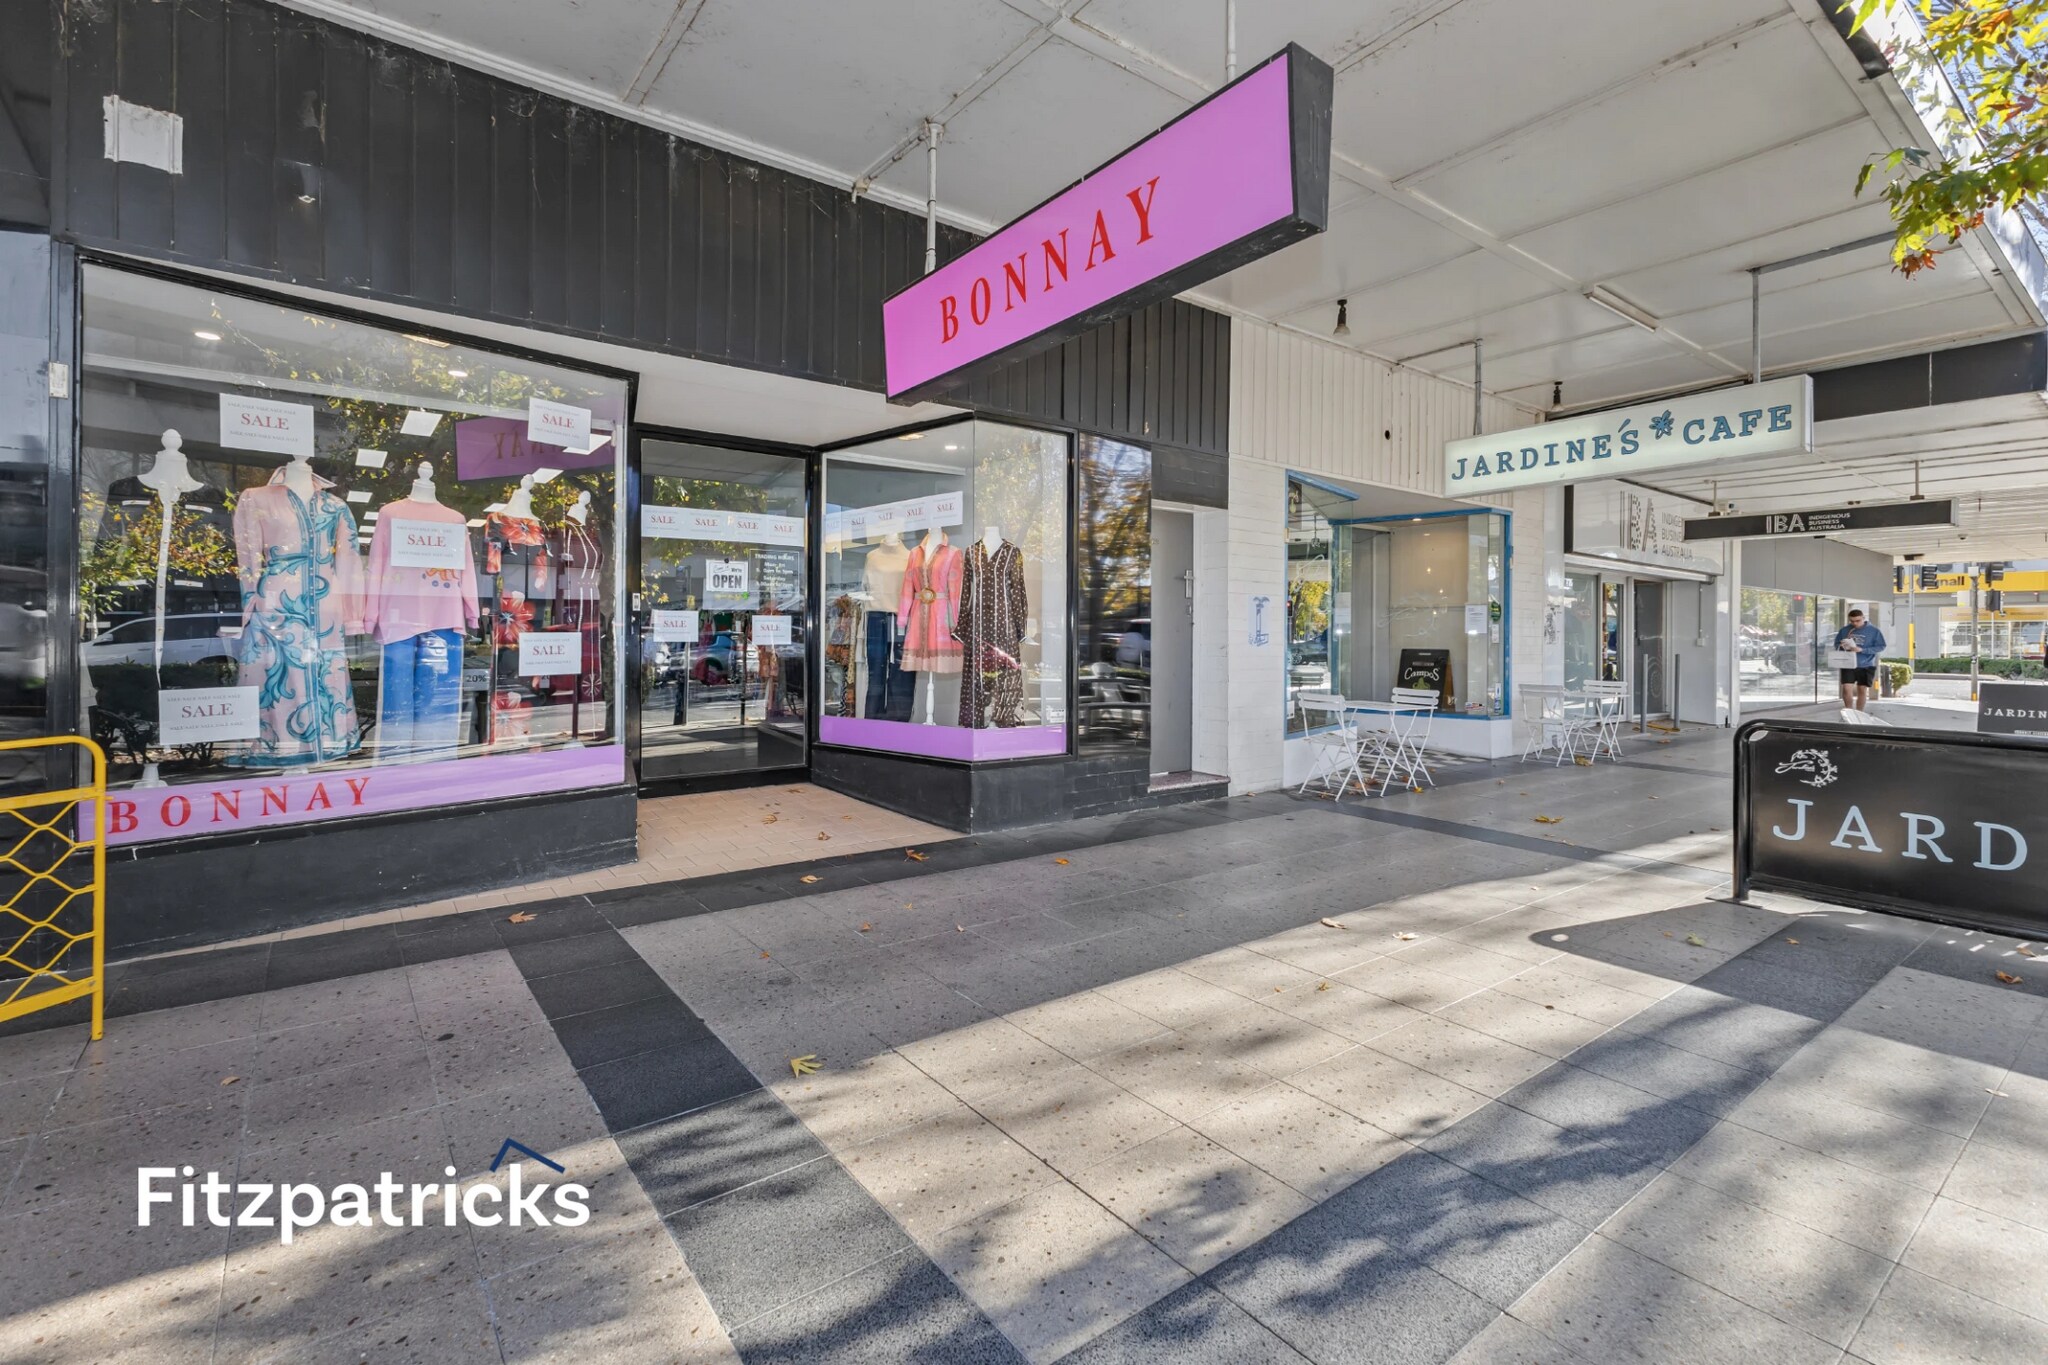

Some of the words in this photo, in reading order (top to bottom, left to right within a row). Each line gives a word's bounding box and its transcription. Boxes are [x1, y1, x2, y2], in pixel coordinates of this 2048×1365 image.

[940, 176, 1161, 344] BONNAY
[241, 412, 289, 431] SALE
[542, 413, 575, 429] SALE
[1451, 418, 1640, 481] JARDINE'S
[1682, 404, 1793, 445] CAFE
[906, 507, 923, 518] SALE
[937, 503, 954, 513] SALE
[651, 514, 676, 525] SALE
[1808, 512, 1851, 521] INDIGENOUS
[695, 518, 719, 527] SALE
[737, 521, 759, 530] SALE
[1766, 513, 1805, 534] IBA
[1809, 523, 1845, 531] AUSTRALIA
[774, 524, 794, 533] SALE
[407, 533, 446, 547] SALE
[713, 574, 742, 589] OPEN
[663, 620, 687, 628] SALE
[760, 624, 781, 632] SALE
[533, 644, 565, 656] SALE
[466, 674, 487, 683] 20%
[181, 703, 234, 719] SALE
[107, 776, 371, 835] BONNAY
[1772, 798, 2029, 872] JARD
